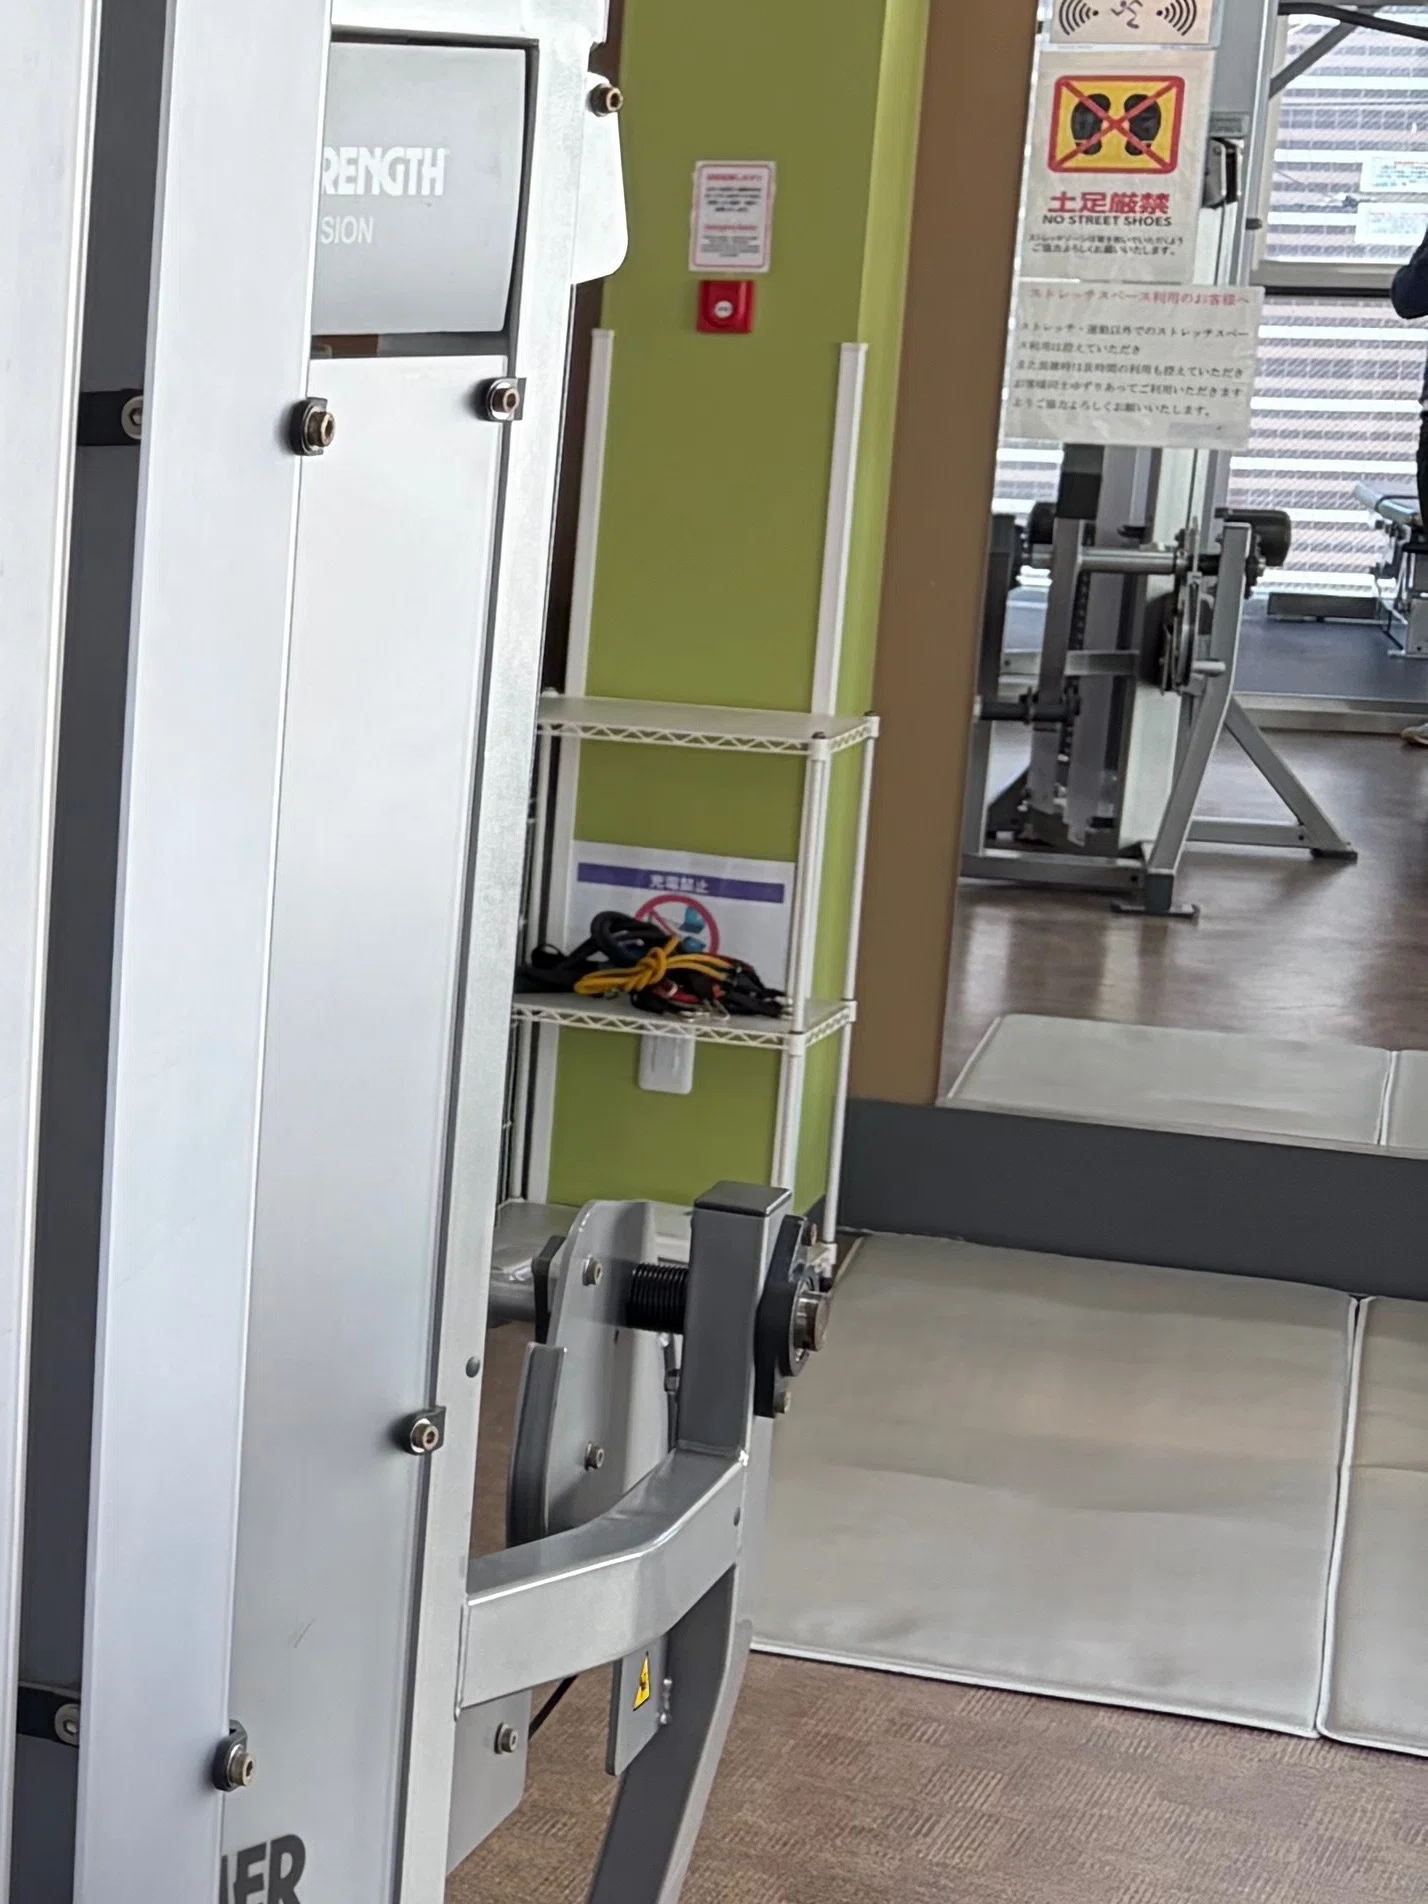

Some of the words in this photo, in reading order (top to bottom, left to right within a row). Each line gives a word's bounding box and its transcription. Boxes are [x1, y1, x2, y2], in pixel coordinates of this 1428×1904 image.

[1047, 191, 1171, 215] 土足厳禁
[1042, 214, 1065, 225] NO
[1069, 215, 1119, 226] STREET
[1124, 216, 1172, 227] SHOES
